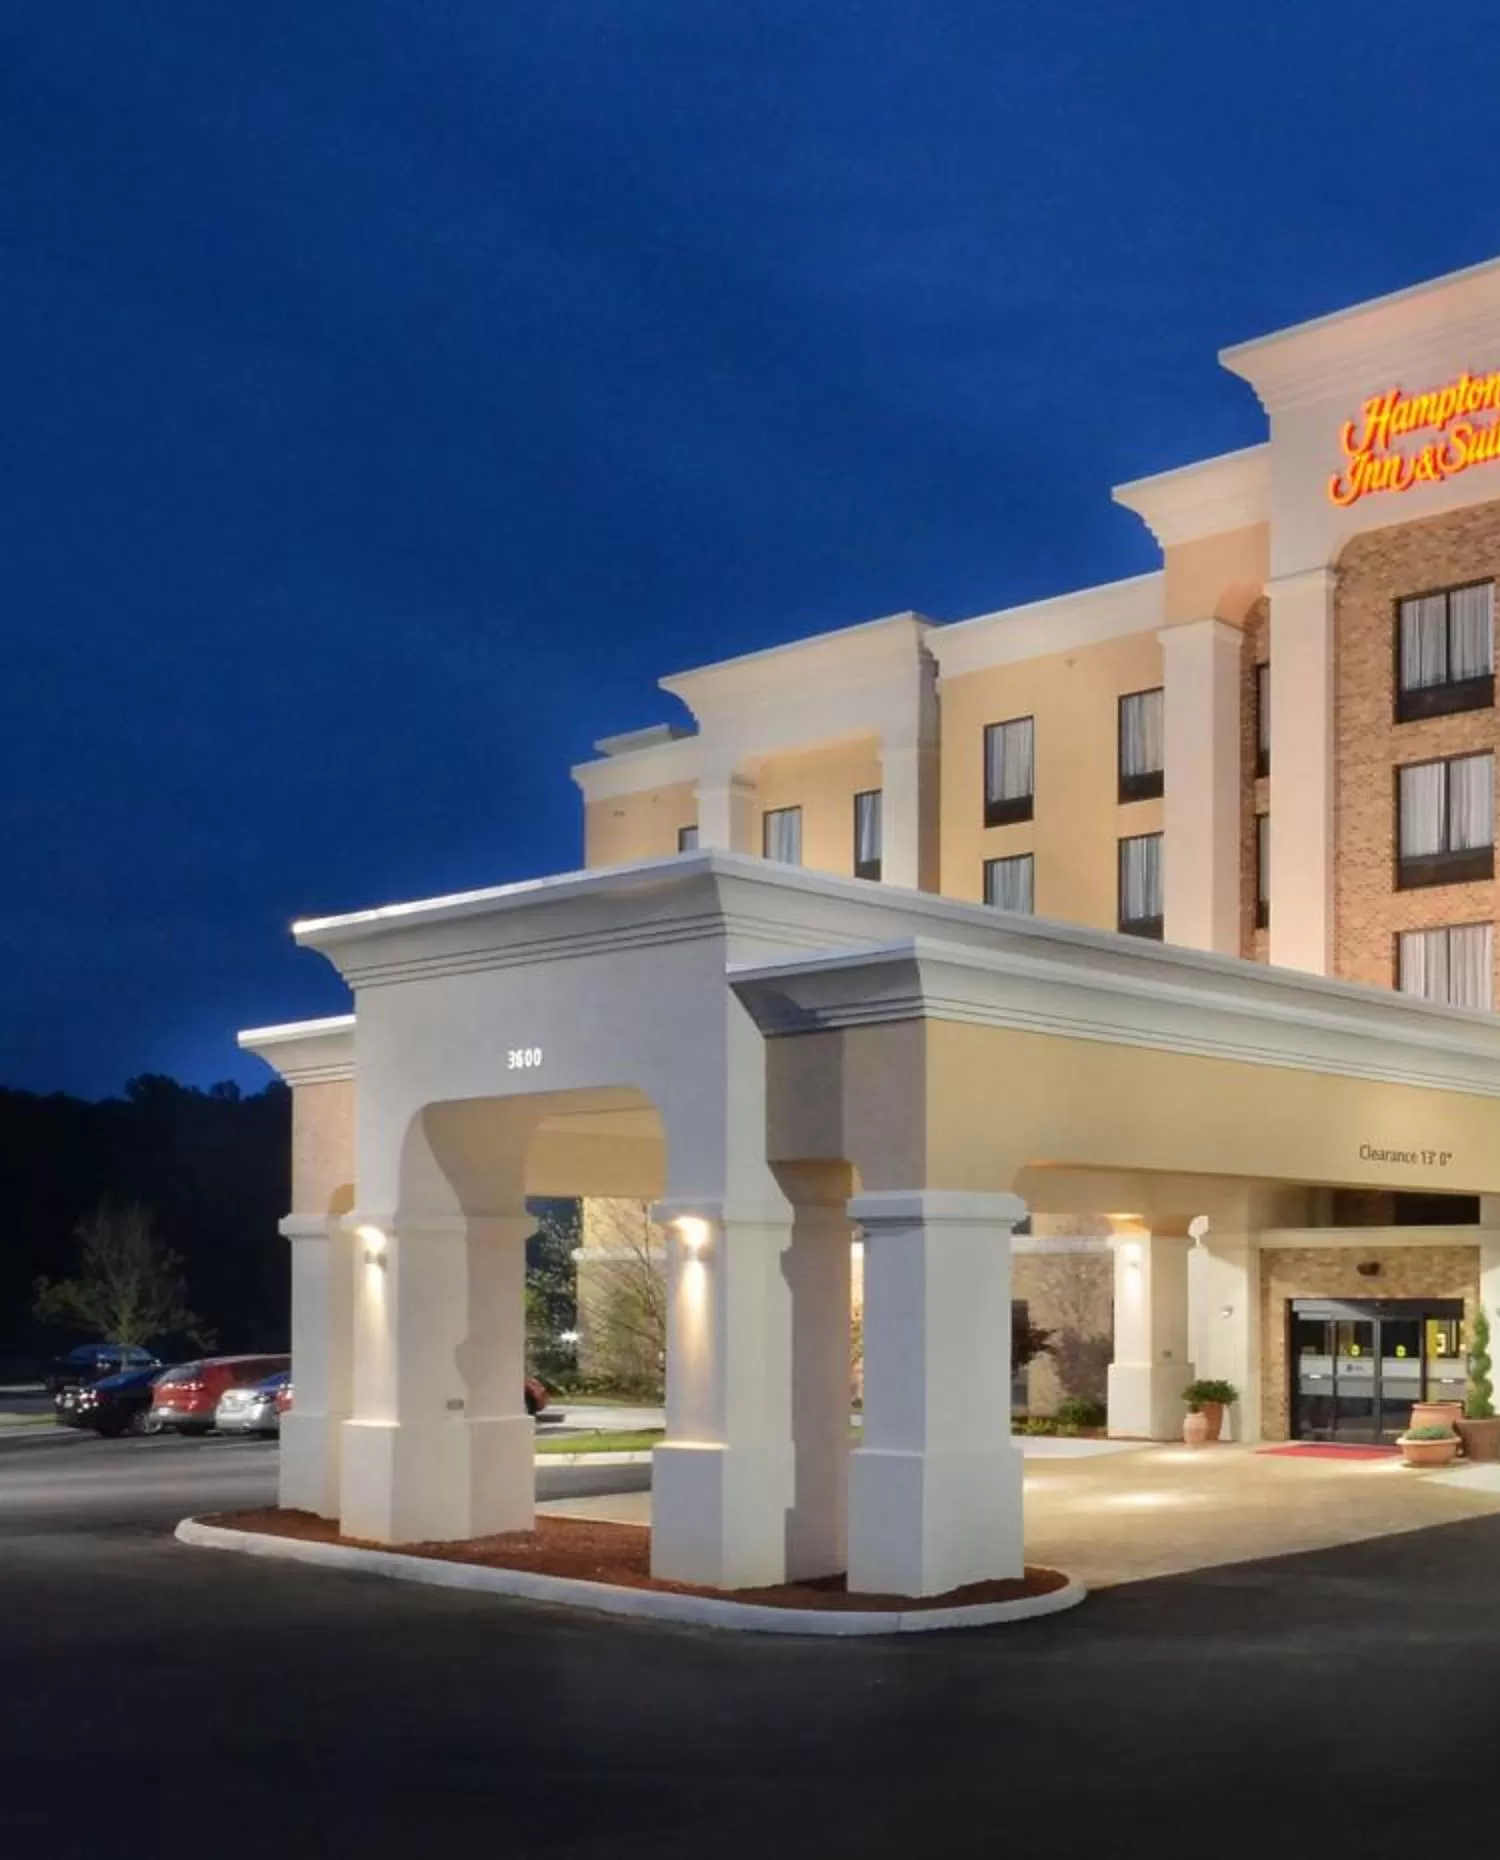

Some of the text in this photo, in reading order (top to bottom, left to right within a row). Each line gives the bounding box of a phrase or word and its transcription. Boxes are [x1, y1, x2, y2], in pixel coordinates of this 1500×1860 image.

[1329, 449, 1416, 506] Inn
[1413, 445, 1444, 481] &
[507, 1046, 543, 1070] 3600
[1359, 1143, 1418, 1165] Clearance
